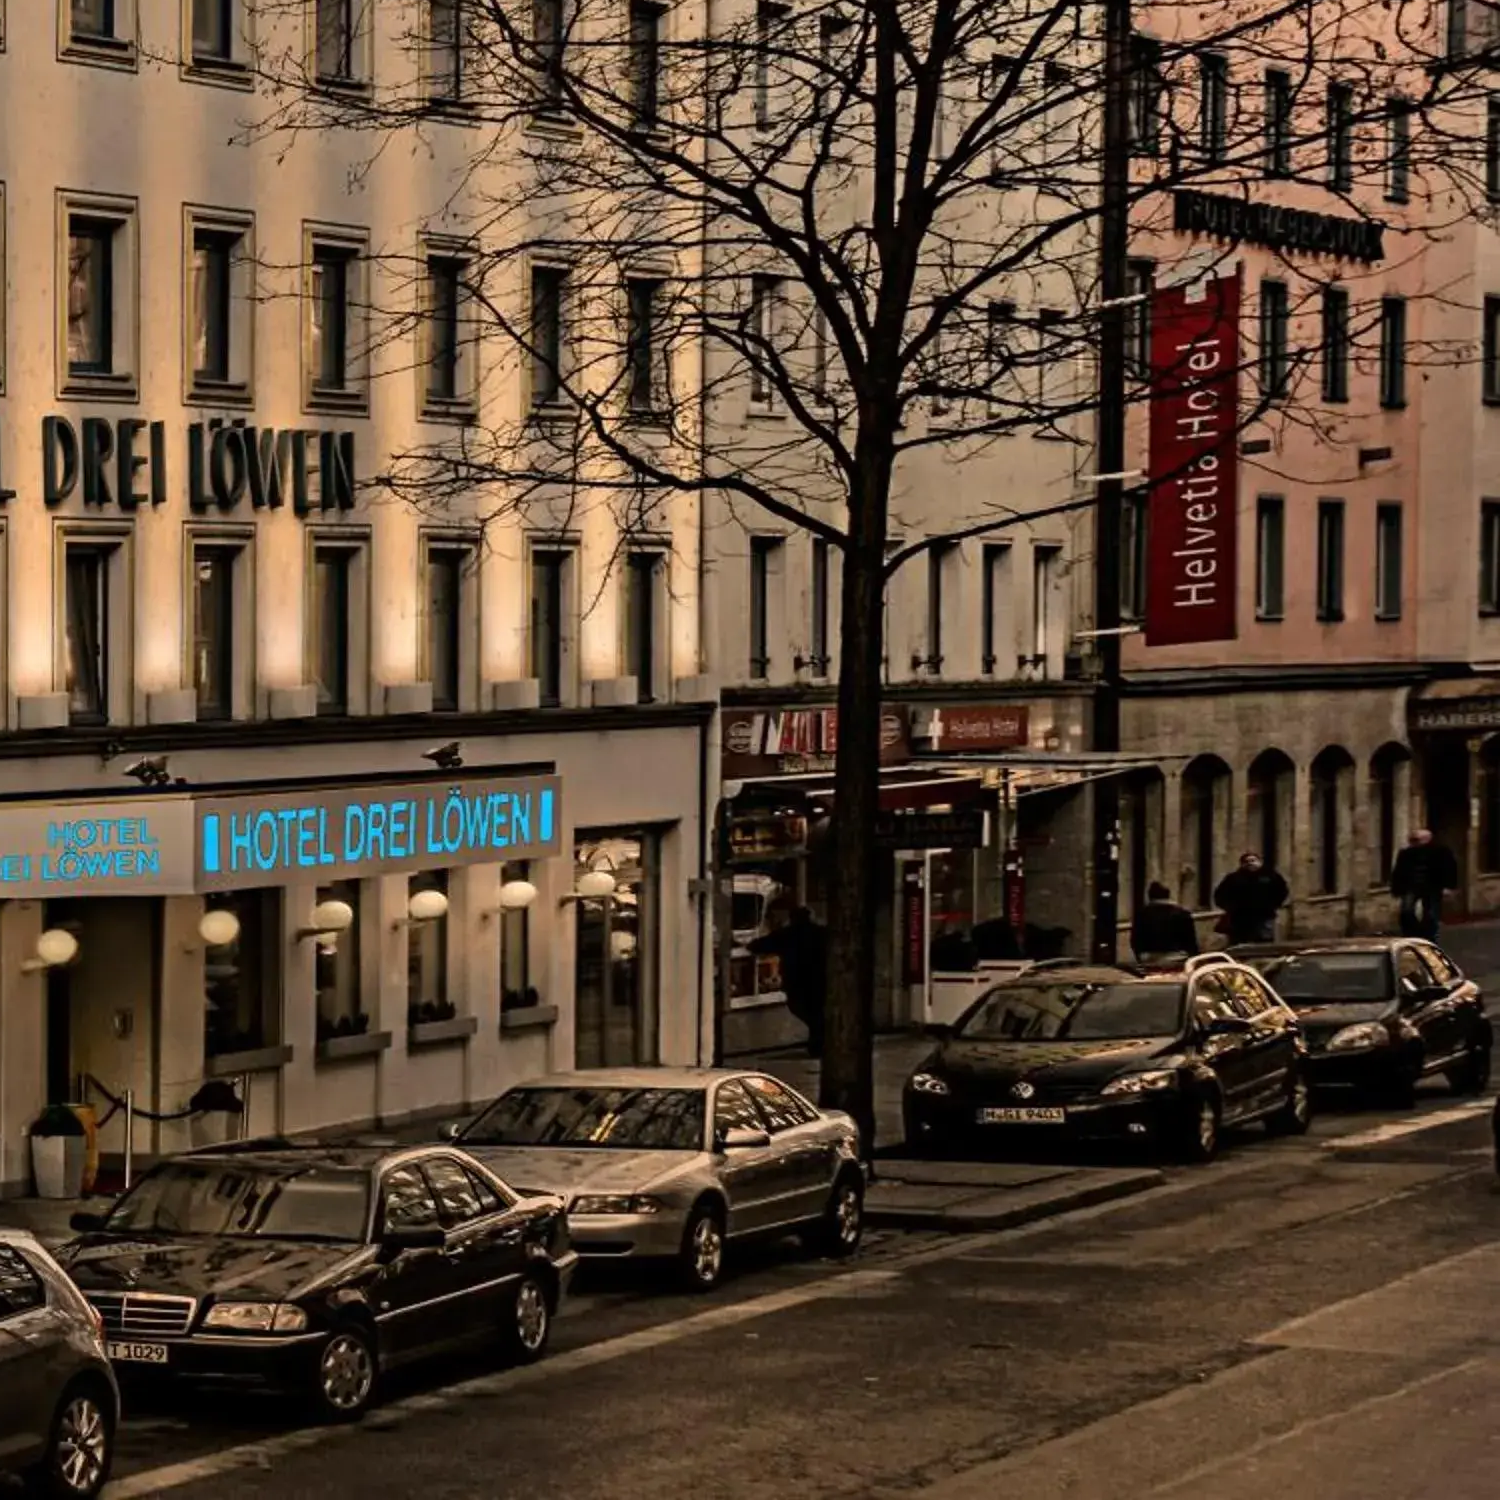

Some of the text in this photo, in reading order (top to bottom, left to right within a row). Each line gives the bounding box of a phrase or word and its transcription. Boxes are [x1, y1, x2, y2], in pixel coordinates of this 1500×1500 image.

[42, 414, 167, 512] DREI
[187, 417, 356, 519] LÖWEN
[1171, 339, 1220, 608] Helvetia Hotel
[47, 818, 158, 848] HOTEL
[230, 787, 532, 870] HOTEL DREI LÖWEN
[40, 847, 160, 881] LÖWEN
[110, 1343, 165, 1360] T 1029
